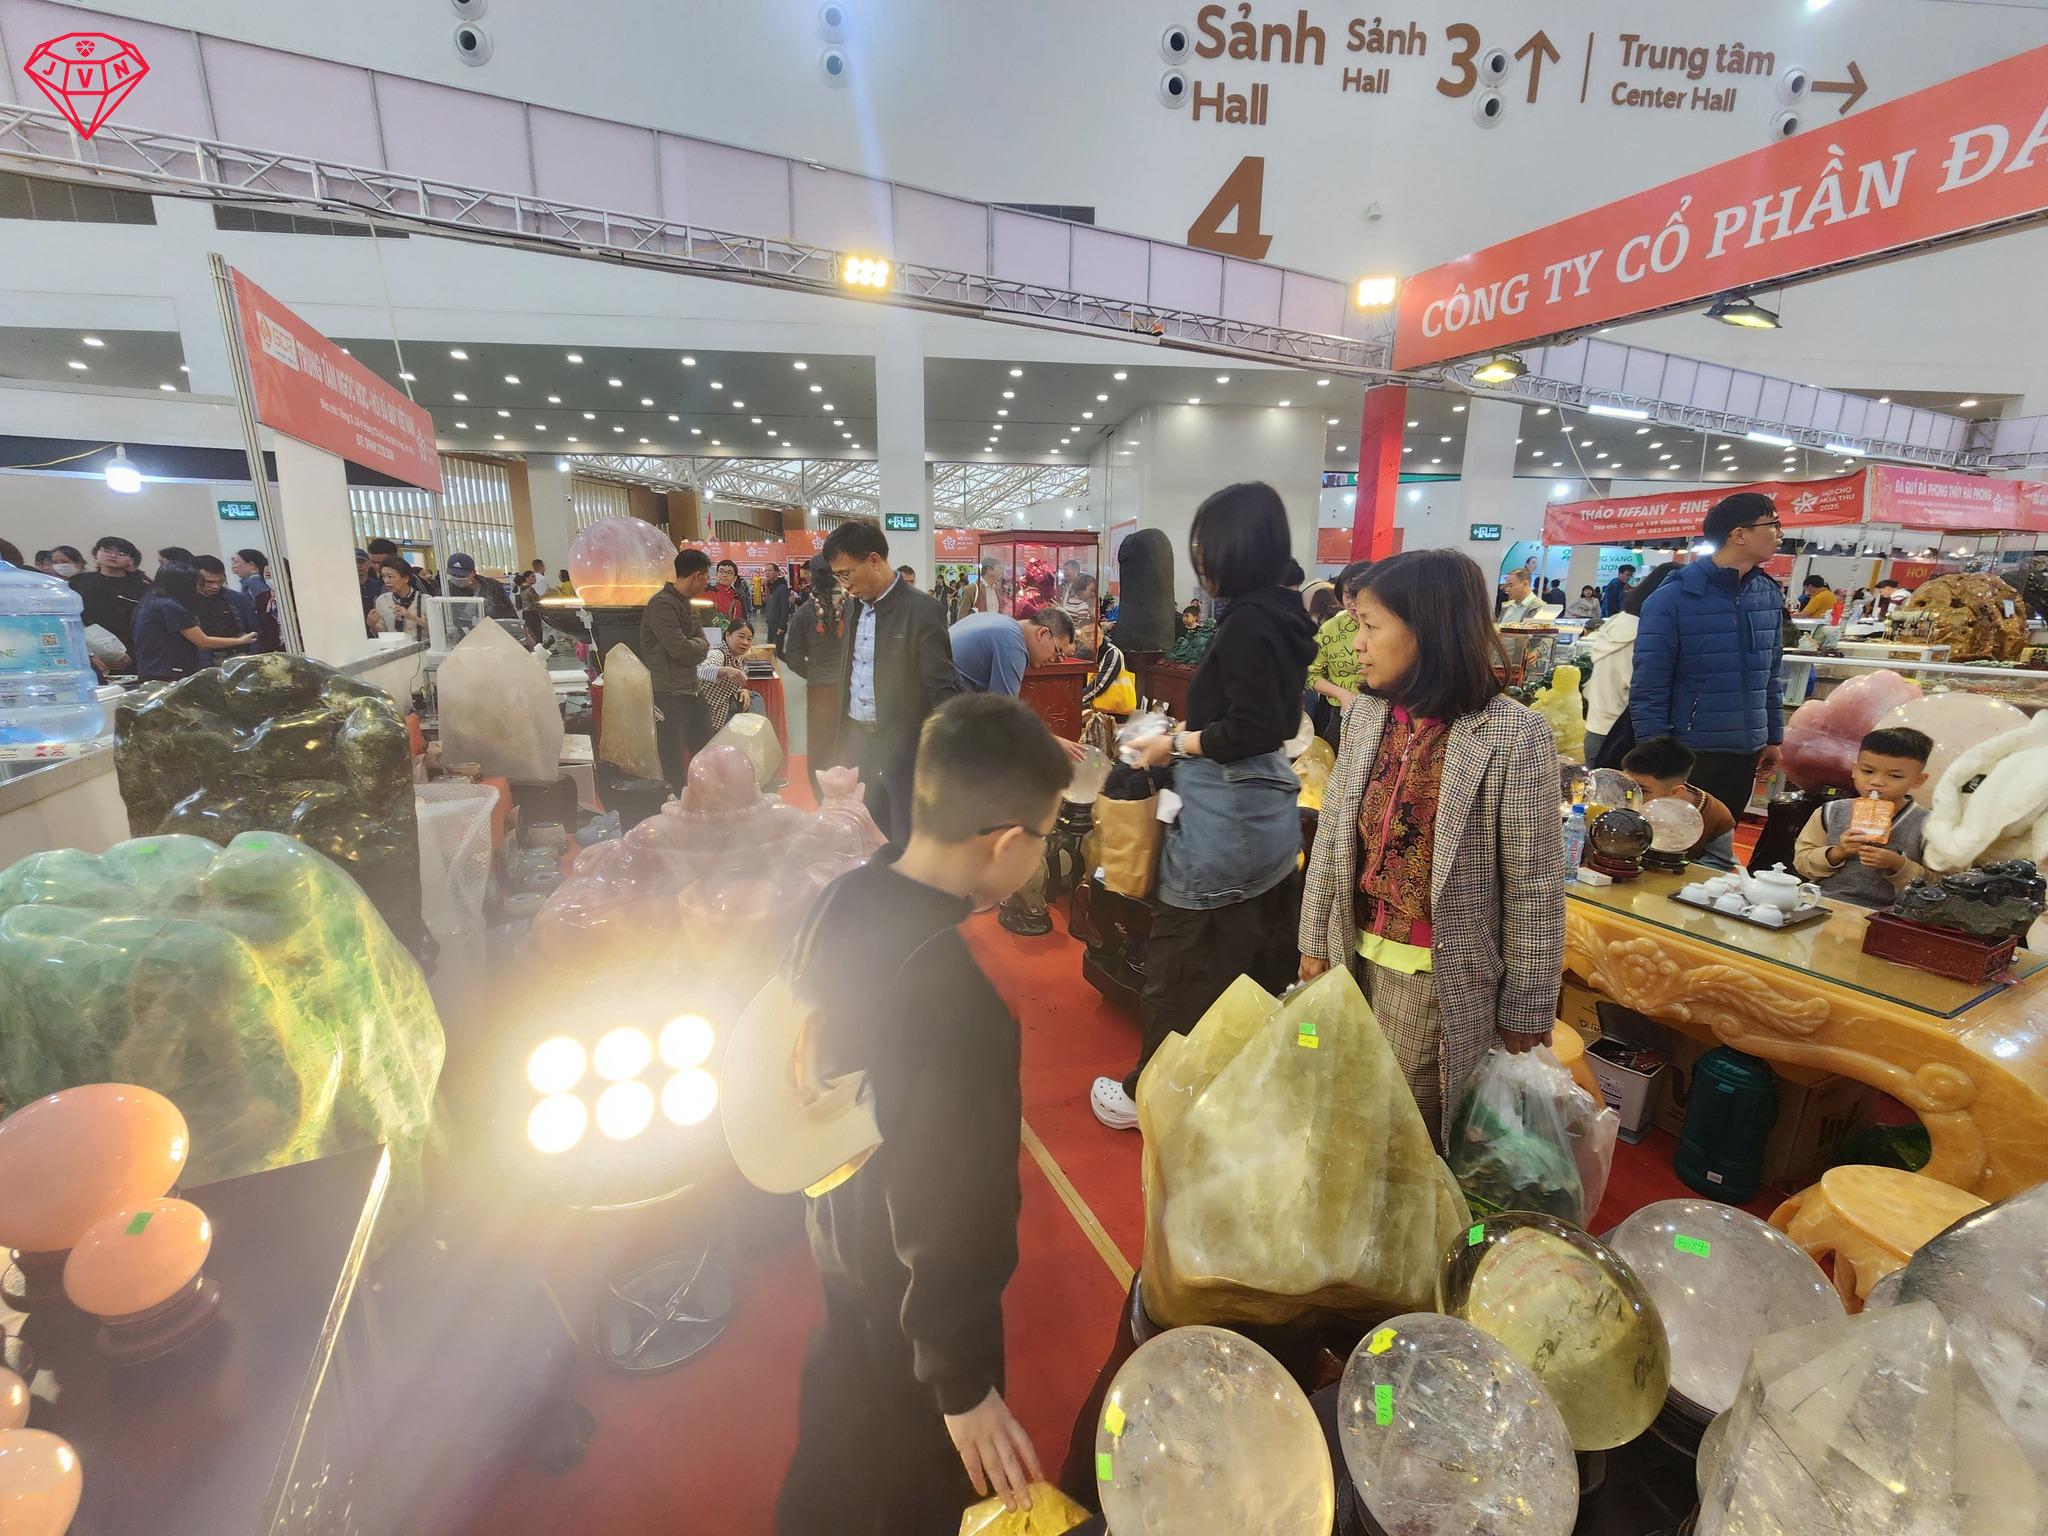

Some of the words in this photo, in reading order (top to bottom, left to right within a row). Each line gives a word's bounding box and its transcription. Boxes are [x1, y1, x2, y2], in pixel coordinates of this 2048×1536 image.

[1194, 2, 1326, 65] Sảnh
[1346, 17, 1427, 56] Sảnh
[1436, 22, 1481, 98] 3
[1619, 34, 1710, 80] Trung
[1716, 42, 1776, 76] tâm
[1192, 80, 1269, 126] Hall
[1343, 67, 1390, 94] Hall
[1611, 82, 1688, 109] Center
[1691, 86, 1737, 112] Hall
[1187, 155, 1273, 260] 4
[1422, 282, 1529, 338] CÔNG
[1544, 249, 1604, 305] TY
[1616, 194, 1693, 284] CỔ
[1705, 143, 1917, 260] PHẦN
[1617, 503, 1668, 518] TIFFANY
[1679, 499, 1710, 514] FINE
